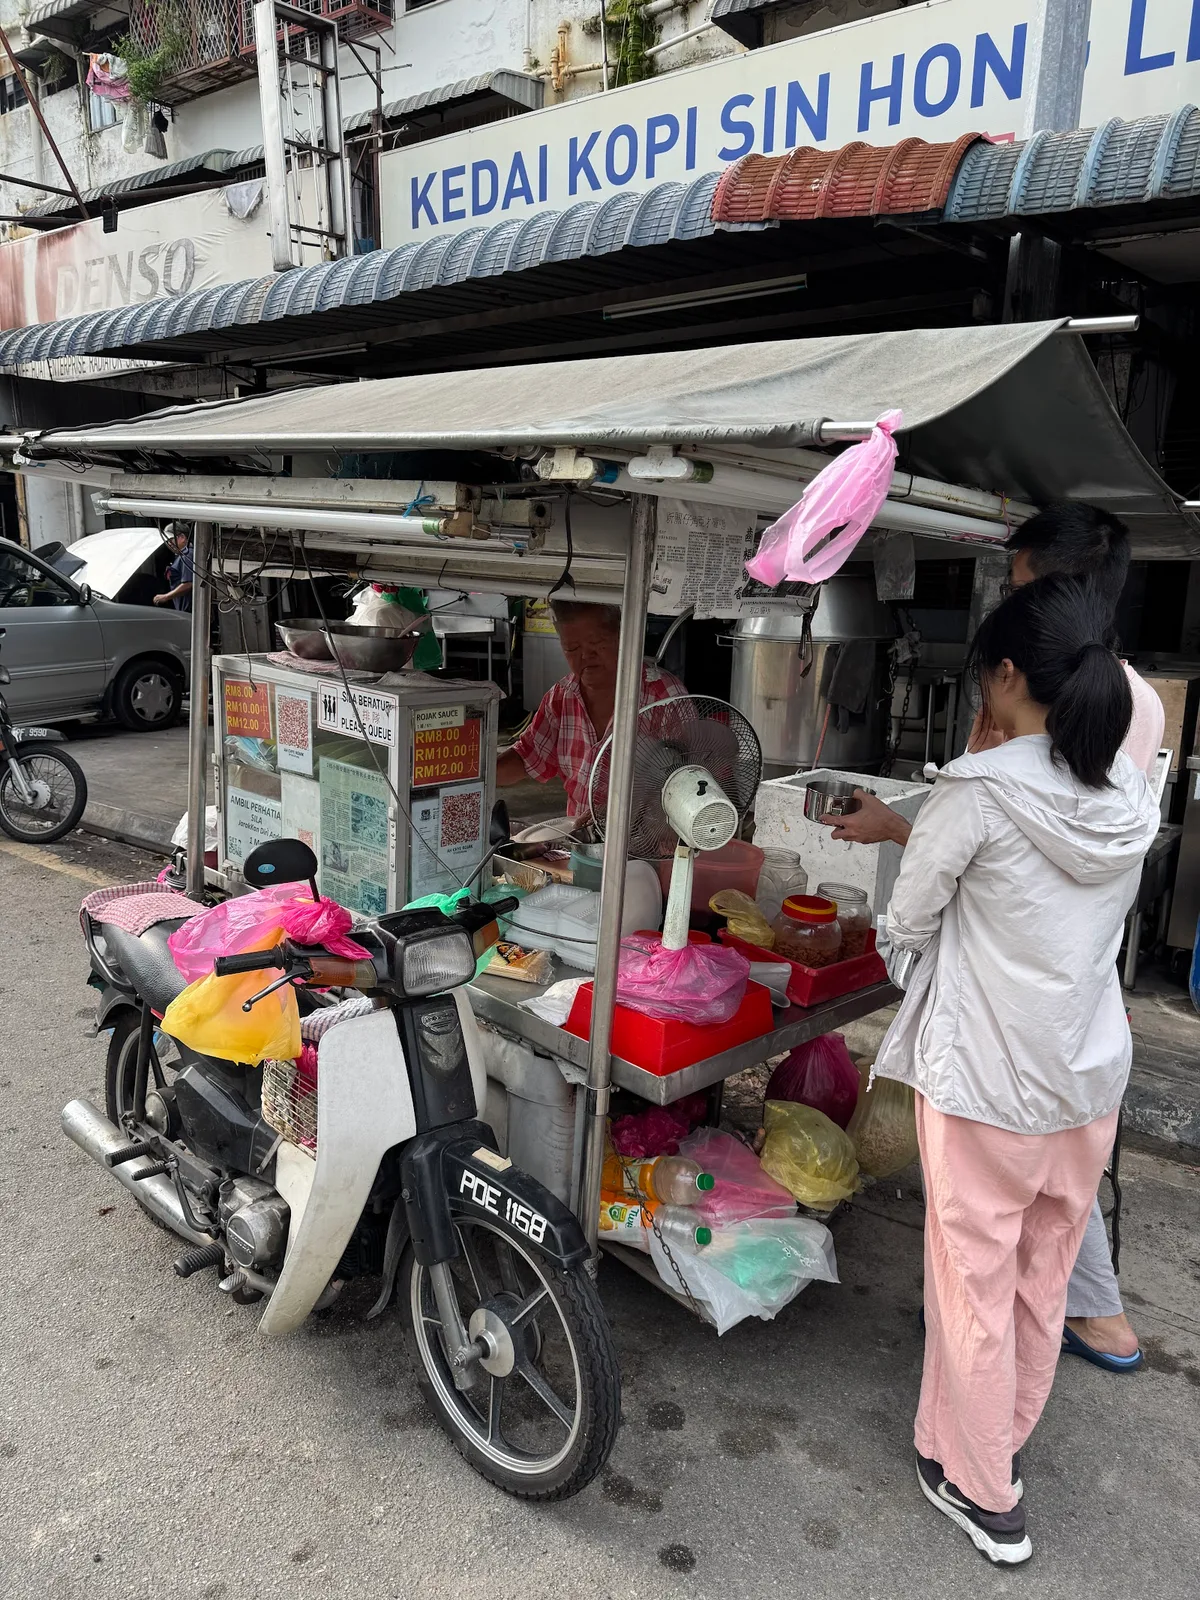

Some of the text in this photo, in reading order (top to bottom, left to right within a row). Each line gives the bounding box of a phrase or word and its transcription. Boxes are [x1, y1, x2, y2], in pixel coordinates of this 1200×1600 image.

[410, 144, 548, 229] KEDAI
[568, 106, 698, 196] KOPI
[717, 72, 831, 161] SIN
[857, 22, 1090, 133] HON
[56, 238, 196, 315] DENSO
[225, 684, 253, 698] RM8.00
[226, 700, 268, 717] RM10.00 中
[416, 709, 459, 721] ROJAK SAUCE
[227, 716, 270, 733] RM12.00 大
[368, 724, 392, 741] QUEUE
[415, 725, 479, 744] RM8.00 小
[415, 742, 478, 762] RM10.00 中
[415, 758, 478, 779] RM12.00 大
[230, 795, 281, 820] AMBIL PERHATIA
[251, 813, 263, 825] SILA
[260, 827, 270, 837] Diri
[506, 1197, 548, 1244] 1158
